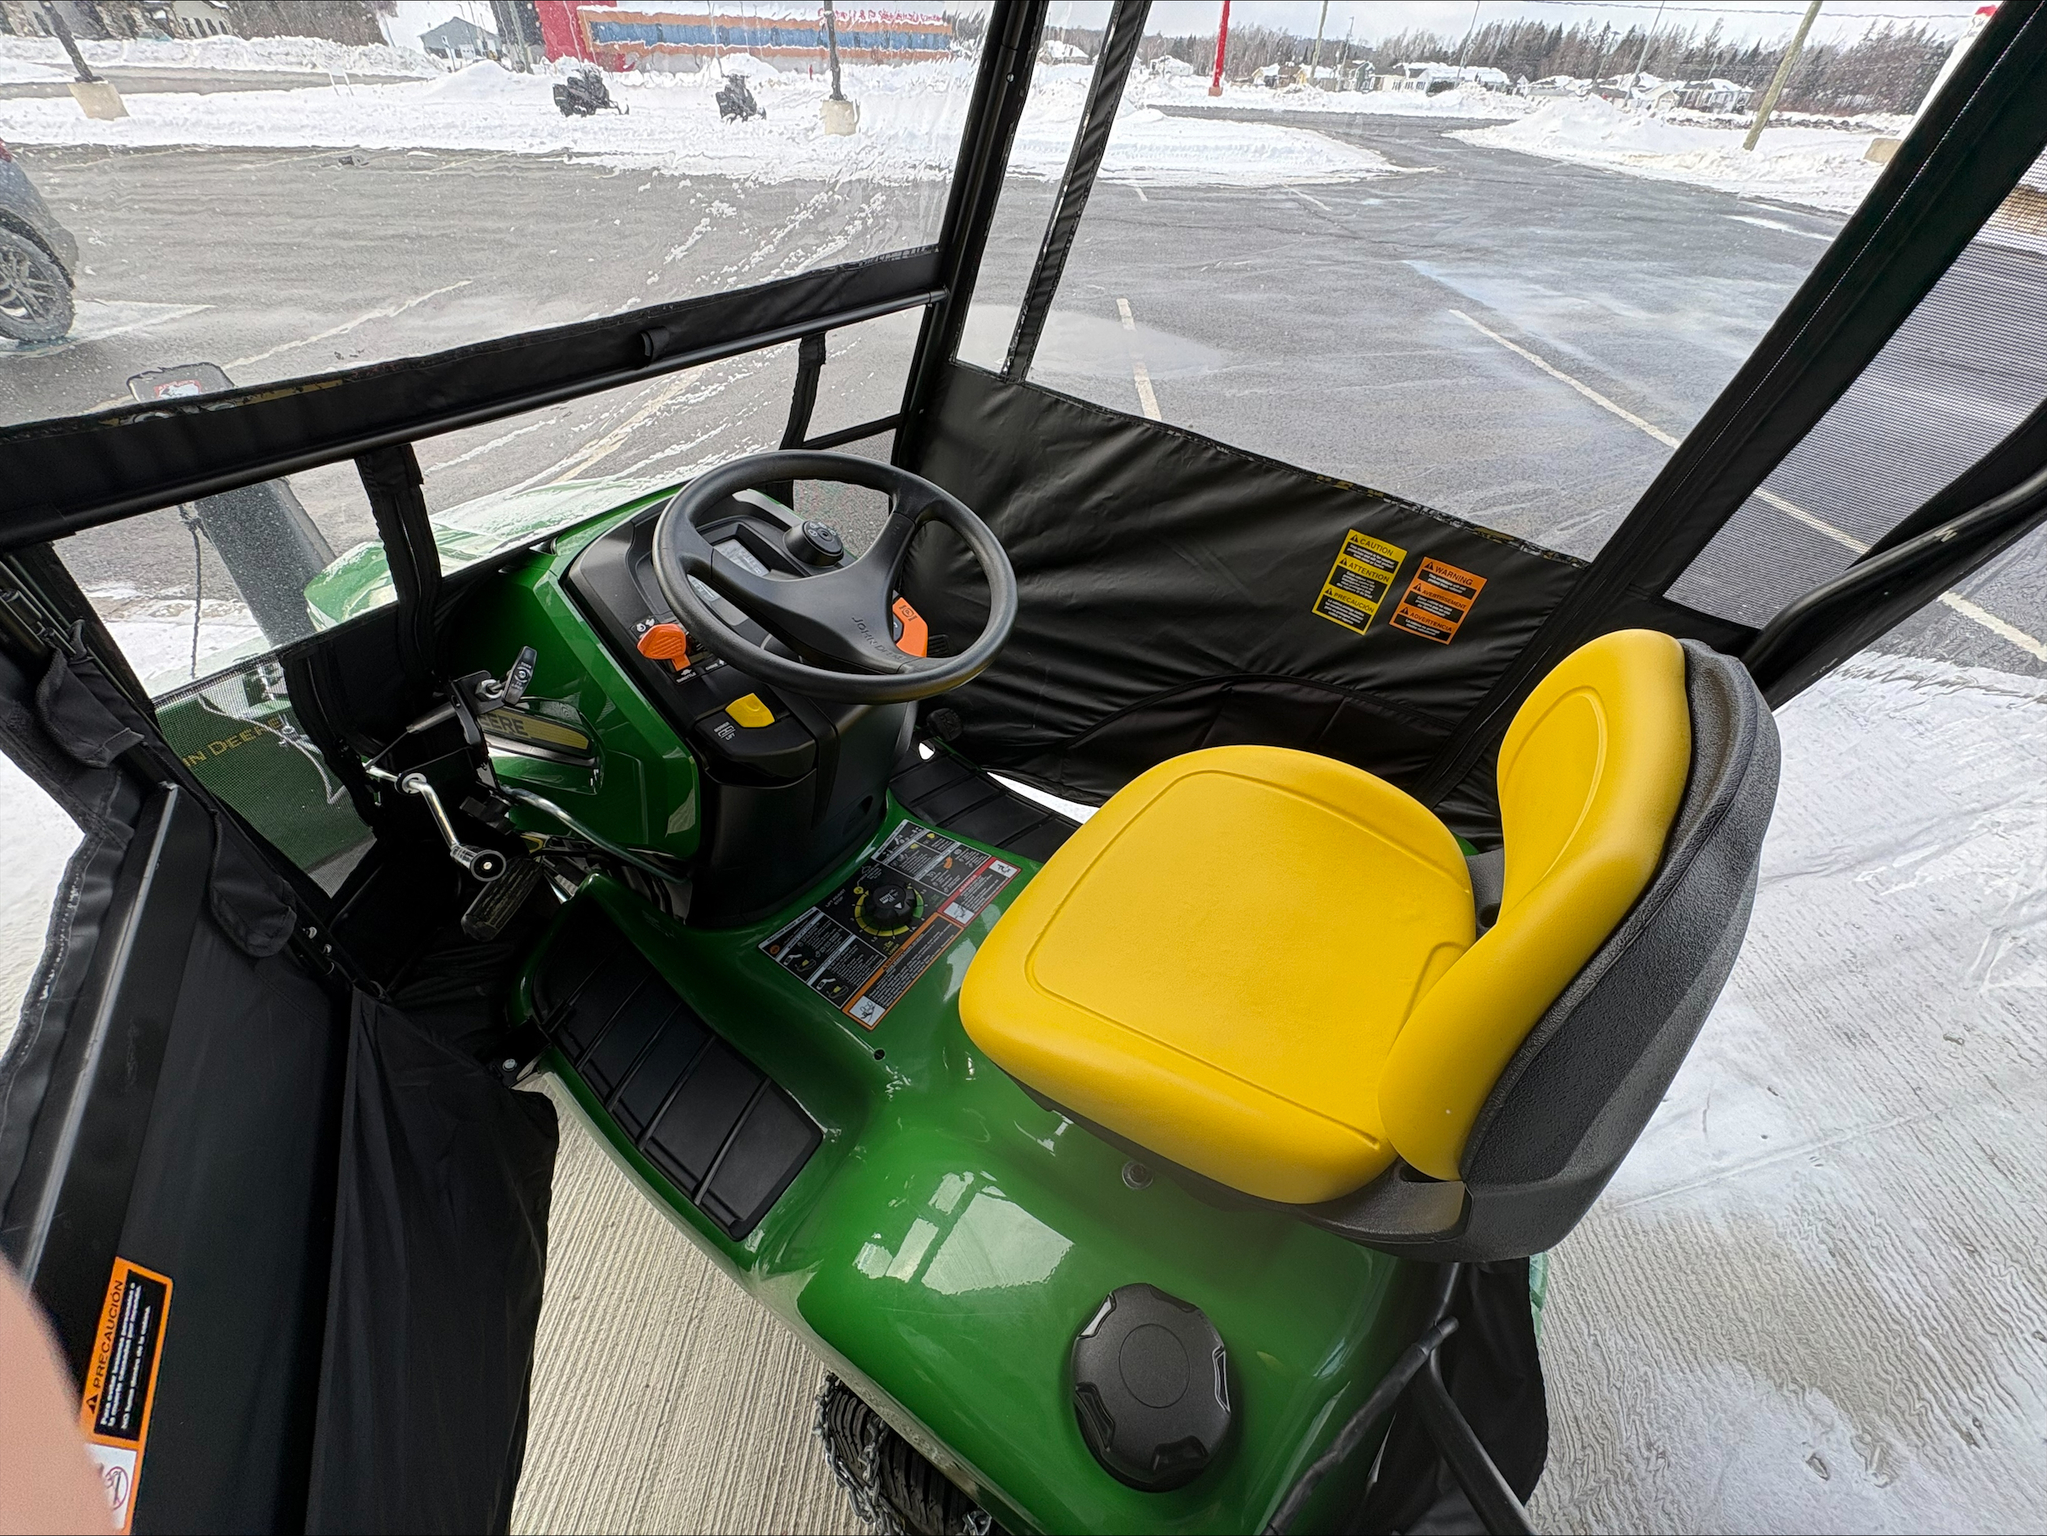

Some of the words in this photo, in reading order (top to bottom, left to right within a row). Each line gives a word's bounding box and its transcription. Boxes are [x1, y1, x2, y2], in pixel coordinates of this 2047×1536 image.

[1360, 538, 1394, 556] CAUTION
[1348, 562, 1391, 583] ATTENTION
[1435, 566, 1473, 586] WARNING
[1333, 592, 1375, 614] PRECAUCIÓN
[1421, 588, 1467, 609] AVERTISSEMENT
[851, 615, 878, 651] JOHN
[1409, 612, 1453, 633] ADVERTENCIA
[210, 717, 282, 757] DEERE
[94, 1280, 124, 1388] PRECAUCIÓN
